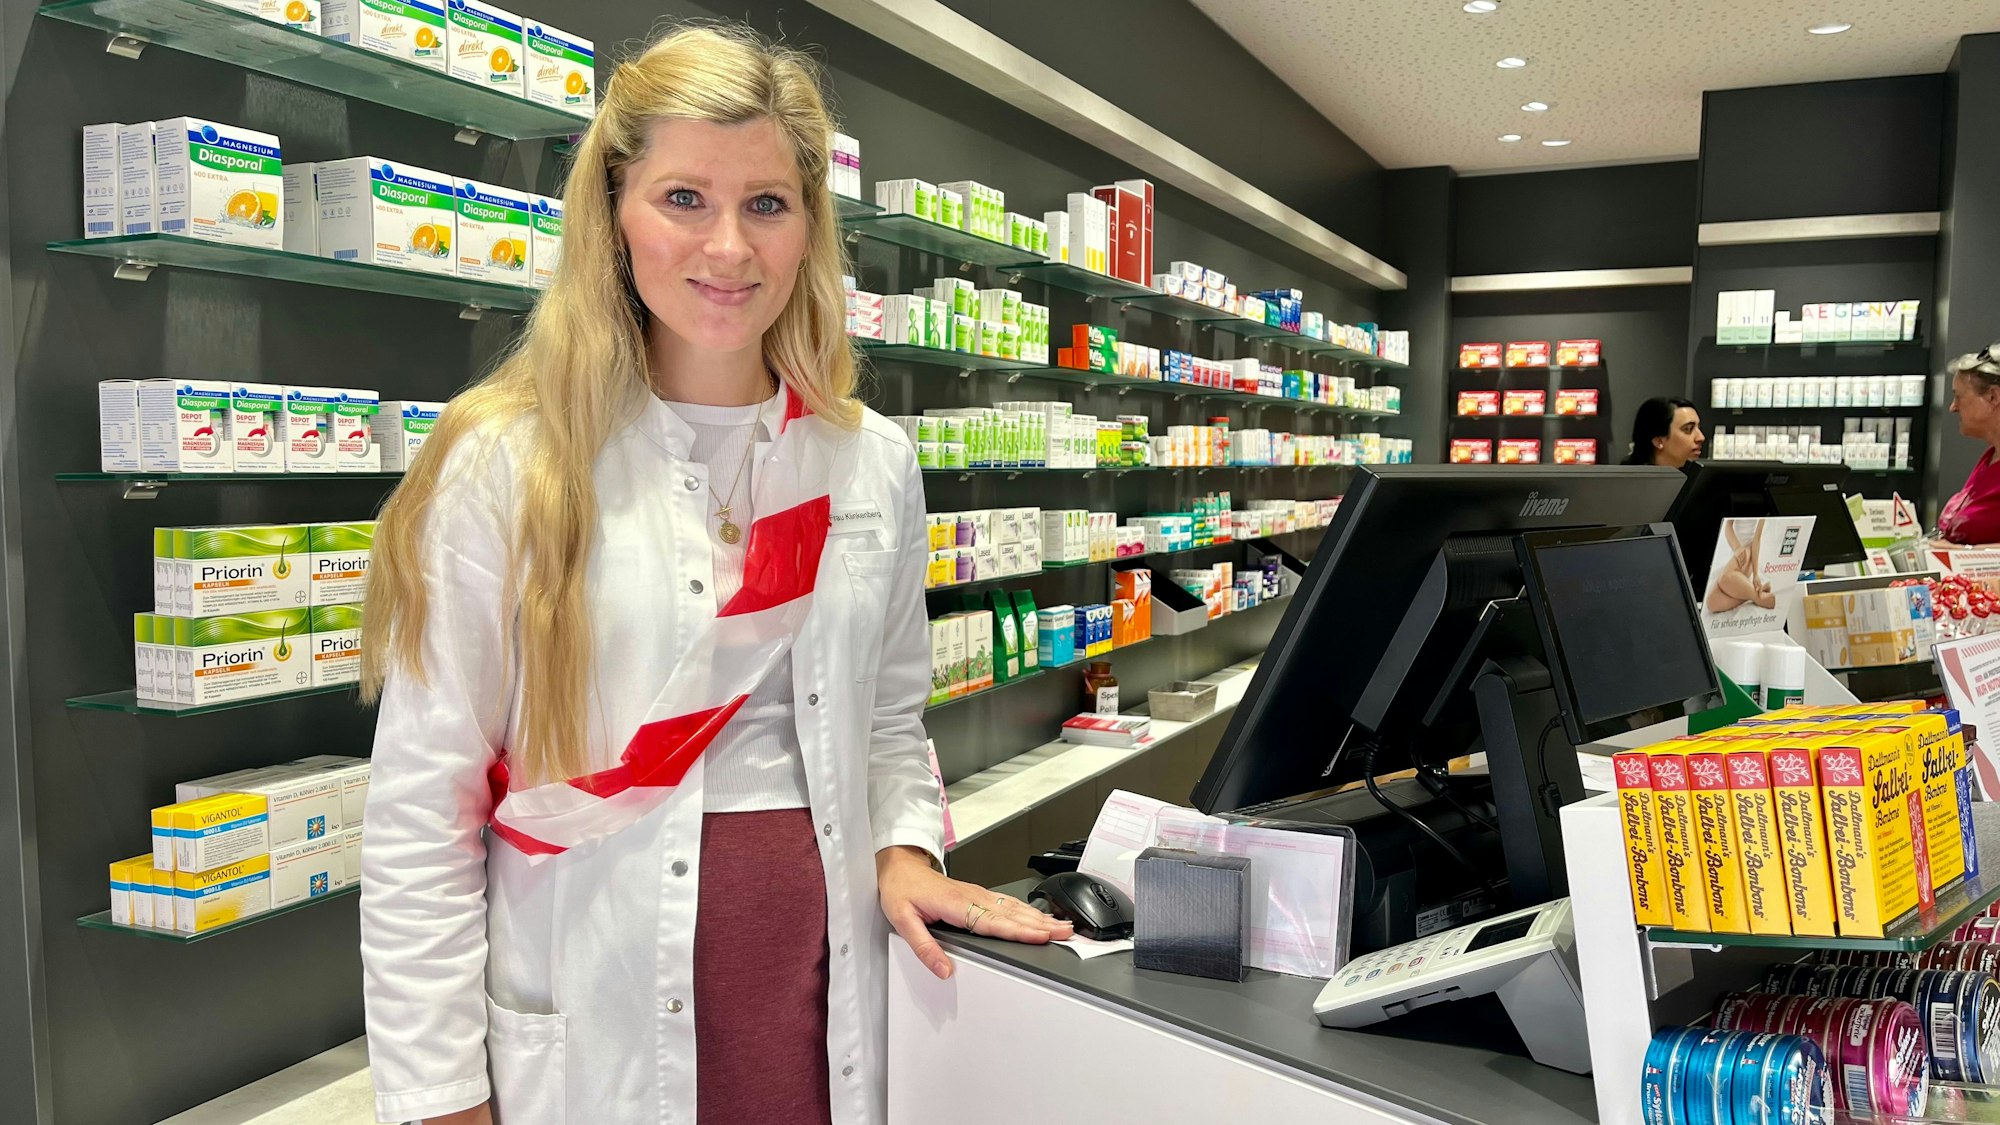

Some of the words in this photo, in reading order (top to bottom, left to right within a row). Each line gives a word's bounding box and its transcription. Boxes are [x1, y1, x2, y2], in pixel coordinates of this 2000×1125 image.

[453, 12, 488, 31] Diasporal
[466, 8, 495, 22] MAGNESIUM
[381, 25, 404, 34] direkt
[460, 28, 476, 38] EXTRA
[459, 40, 484, 53] direkt
[532, 39, 564, 56] Diasporal
[544, 34, 569, 48] MAGNESIUM
[537, 65, 560, 80] direkt
[222, 140, 274, 156] MAGNESIUM
[198, 148, 263, 172] Diasporal
[194, 170, 206, 178] 400
[207, 171, 229, 182] EXTRA
[398, 177, 437, 191] MAGNESIUM
[379, 184, 429, 205] Diasporal
[480, 194, 514, 208] MAGNESIUM
[376, 204, 387, 213] 400
[388, 206, 404, 216] EXTRA
[463, 202, 508, 221] Diasporal
[470, 222, 484, 231] EXTRA
[538, 218, 563, 233] Diaspo
[1802, 304, 1814, 318] A
[1818, 304, 1828, 318] E
[1835, 304, 1848, 318] G
[1868, 302, 1882, 316] N
[1884, 302, 1898, 316] V
[181, 398, 218, 408] Diasporal
[236, 400, 270, 410] Diasporal
[290, 403, 324, 412] Diasporal
[338, 405, 368, 413] Diasporal
[408, 438, 422, 447] pro
[1519, 491, 1569, 517] iiyama
[202, 564, 263, 580] Priorin
[321, 638, 360, 652] Prior
[202, 648, 264, 667] Priorin
[203, 667, 230, 675] KAPSELN
[1868, 746, 1900, 772] Dallmann's
[273, 794, 293, 803] Vitamin
[300, 788, 315, 797] Köhler
[201, 808, 241, 824] VIGANTOL
[1639, 791, 1656, 854] Dallmann's
[1674, 794, 1694, 858] Dallmann's
[1713, 794, 1732, 859] Dallmann's
[1754, 792, 1773, 859] Dallmann's
[1798, 790, 1818, 858] Dallmann's
[1848, 790, 1867, 859] Dallmann's
[276, 852, 295, 861] Vitamin
[302, 845, 317, 854] Köhler
[201, 866, 242, 884] VIGANTOL
